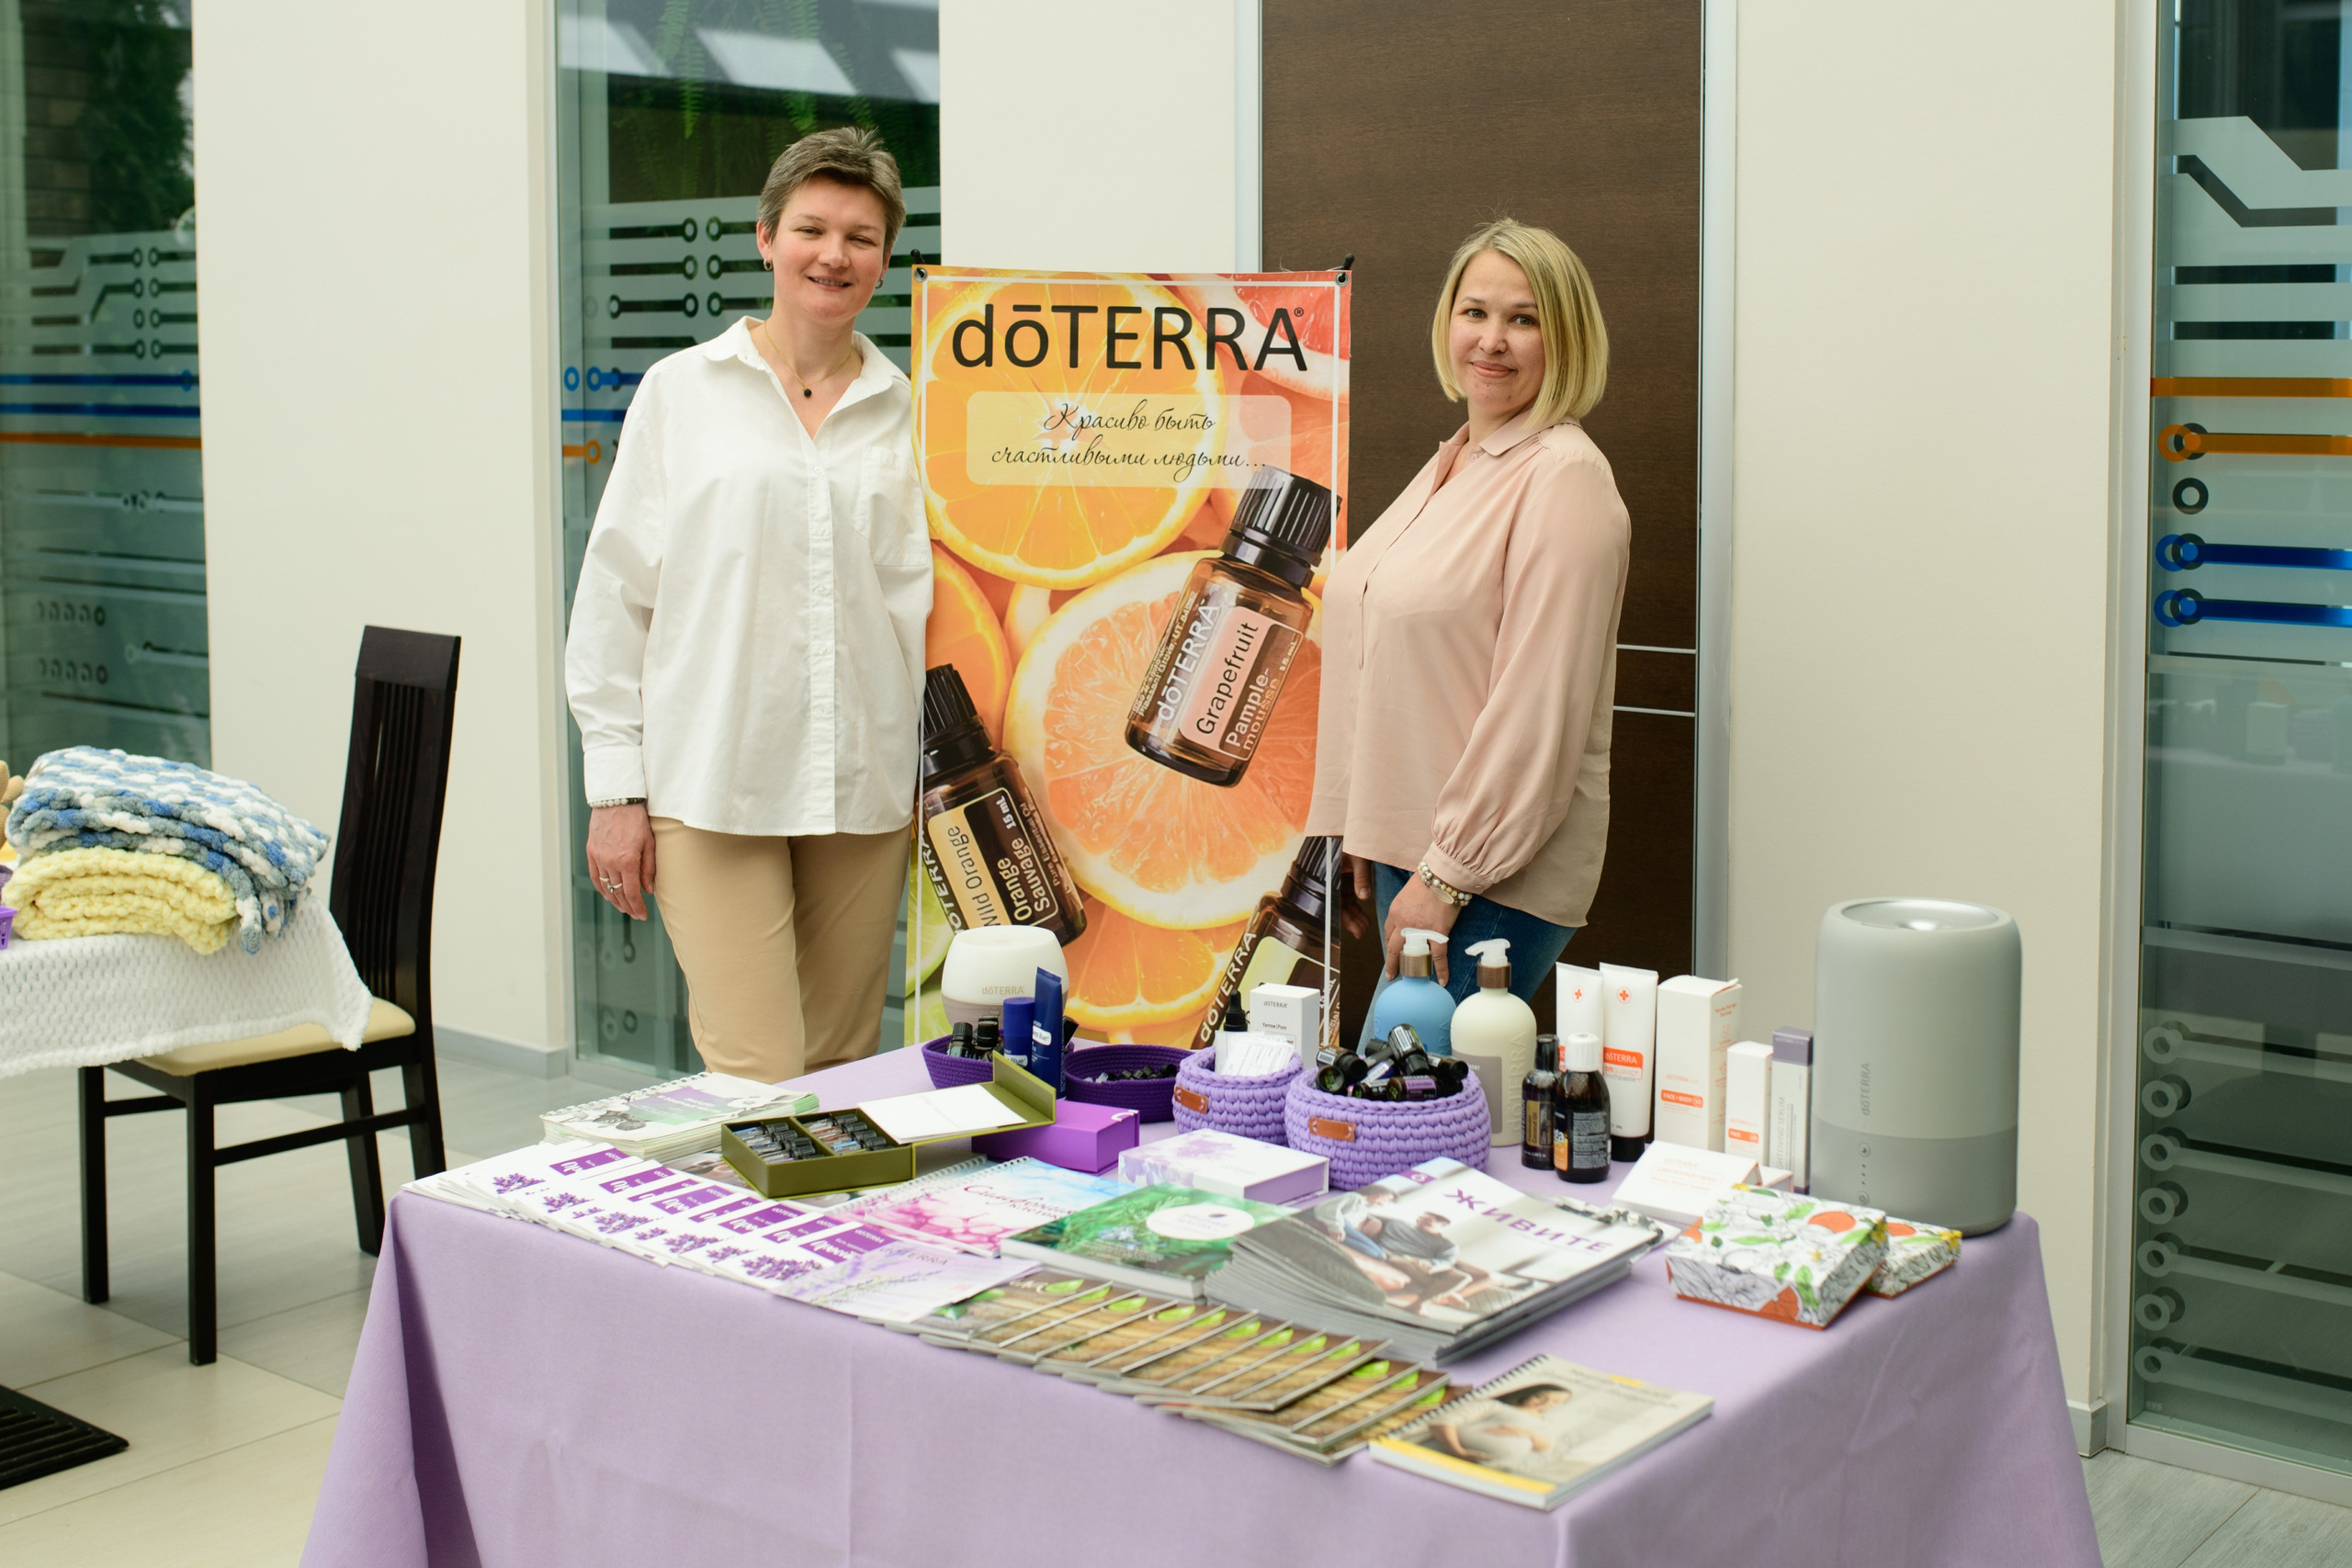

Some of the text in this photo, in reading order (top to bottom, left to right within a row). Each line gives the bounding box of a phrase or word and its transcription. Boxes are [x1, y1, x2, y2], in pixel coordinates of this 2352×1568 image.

[991, 434, 1149, 468] счастливыми
[1044, 399, 1216, 441] Красиво быть
[1196, 622, 1259, 735] Grapefruit
[1225, 667, 1270, 748] Pample-
[1001, 815, 1016, 829] 15
[947, 825, 982, 890] Orange
[997, 856, 1033, 921] Orange
[1011, 837, 1050, 913] Sauvage
[1443, 1189, 1613, 1252] ЖИВИТЕ
